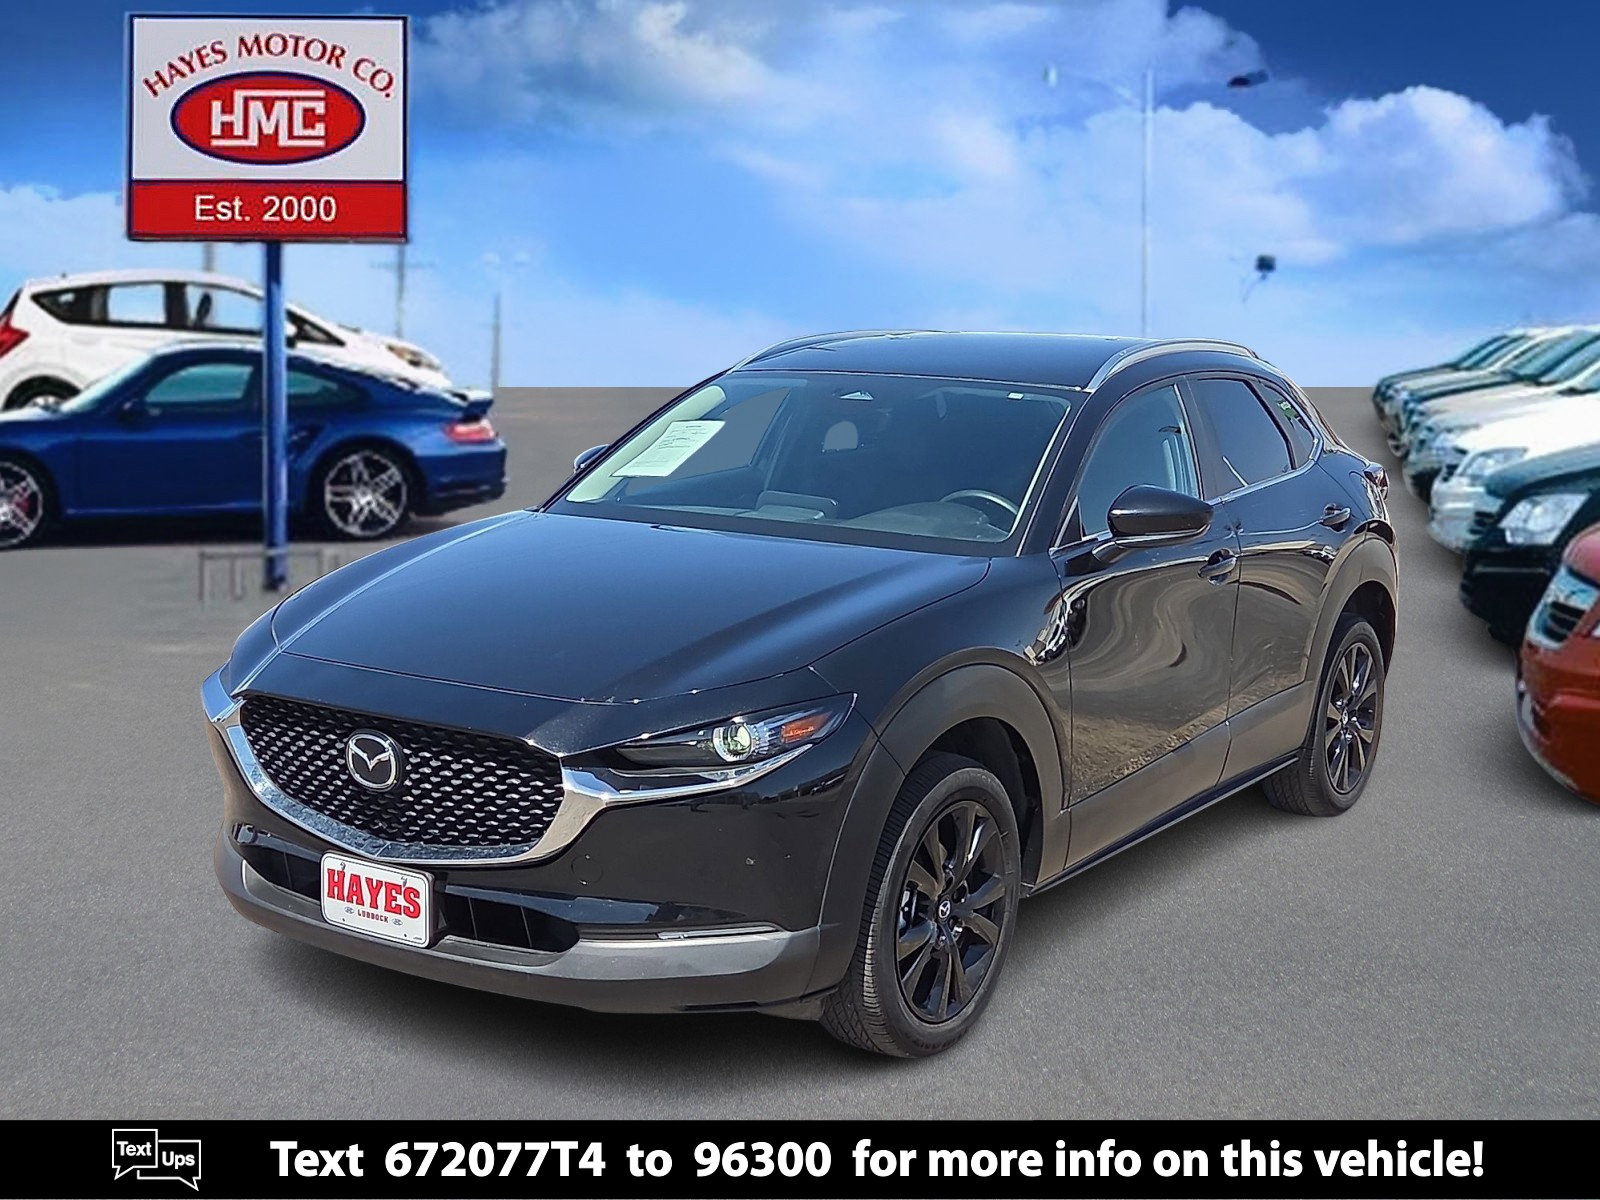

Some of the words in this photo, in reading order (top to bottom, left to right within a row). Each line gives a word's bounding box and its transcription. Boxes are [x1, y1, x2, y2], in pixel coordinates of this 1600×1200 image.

[143, 40, 228, 97] HAYES
[237, 33, 347, 69] MOTOR
[352, 57, 395, 98] CO.
[210, 88, 326, 147] HMC
[195, 194, 250, 222] Est.
[262, 196, 337, 222] 2000
[327, 868, 421, 919] HAYES
